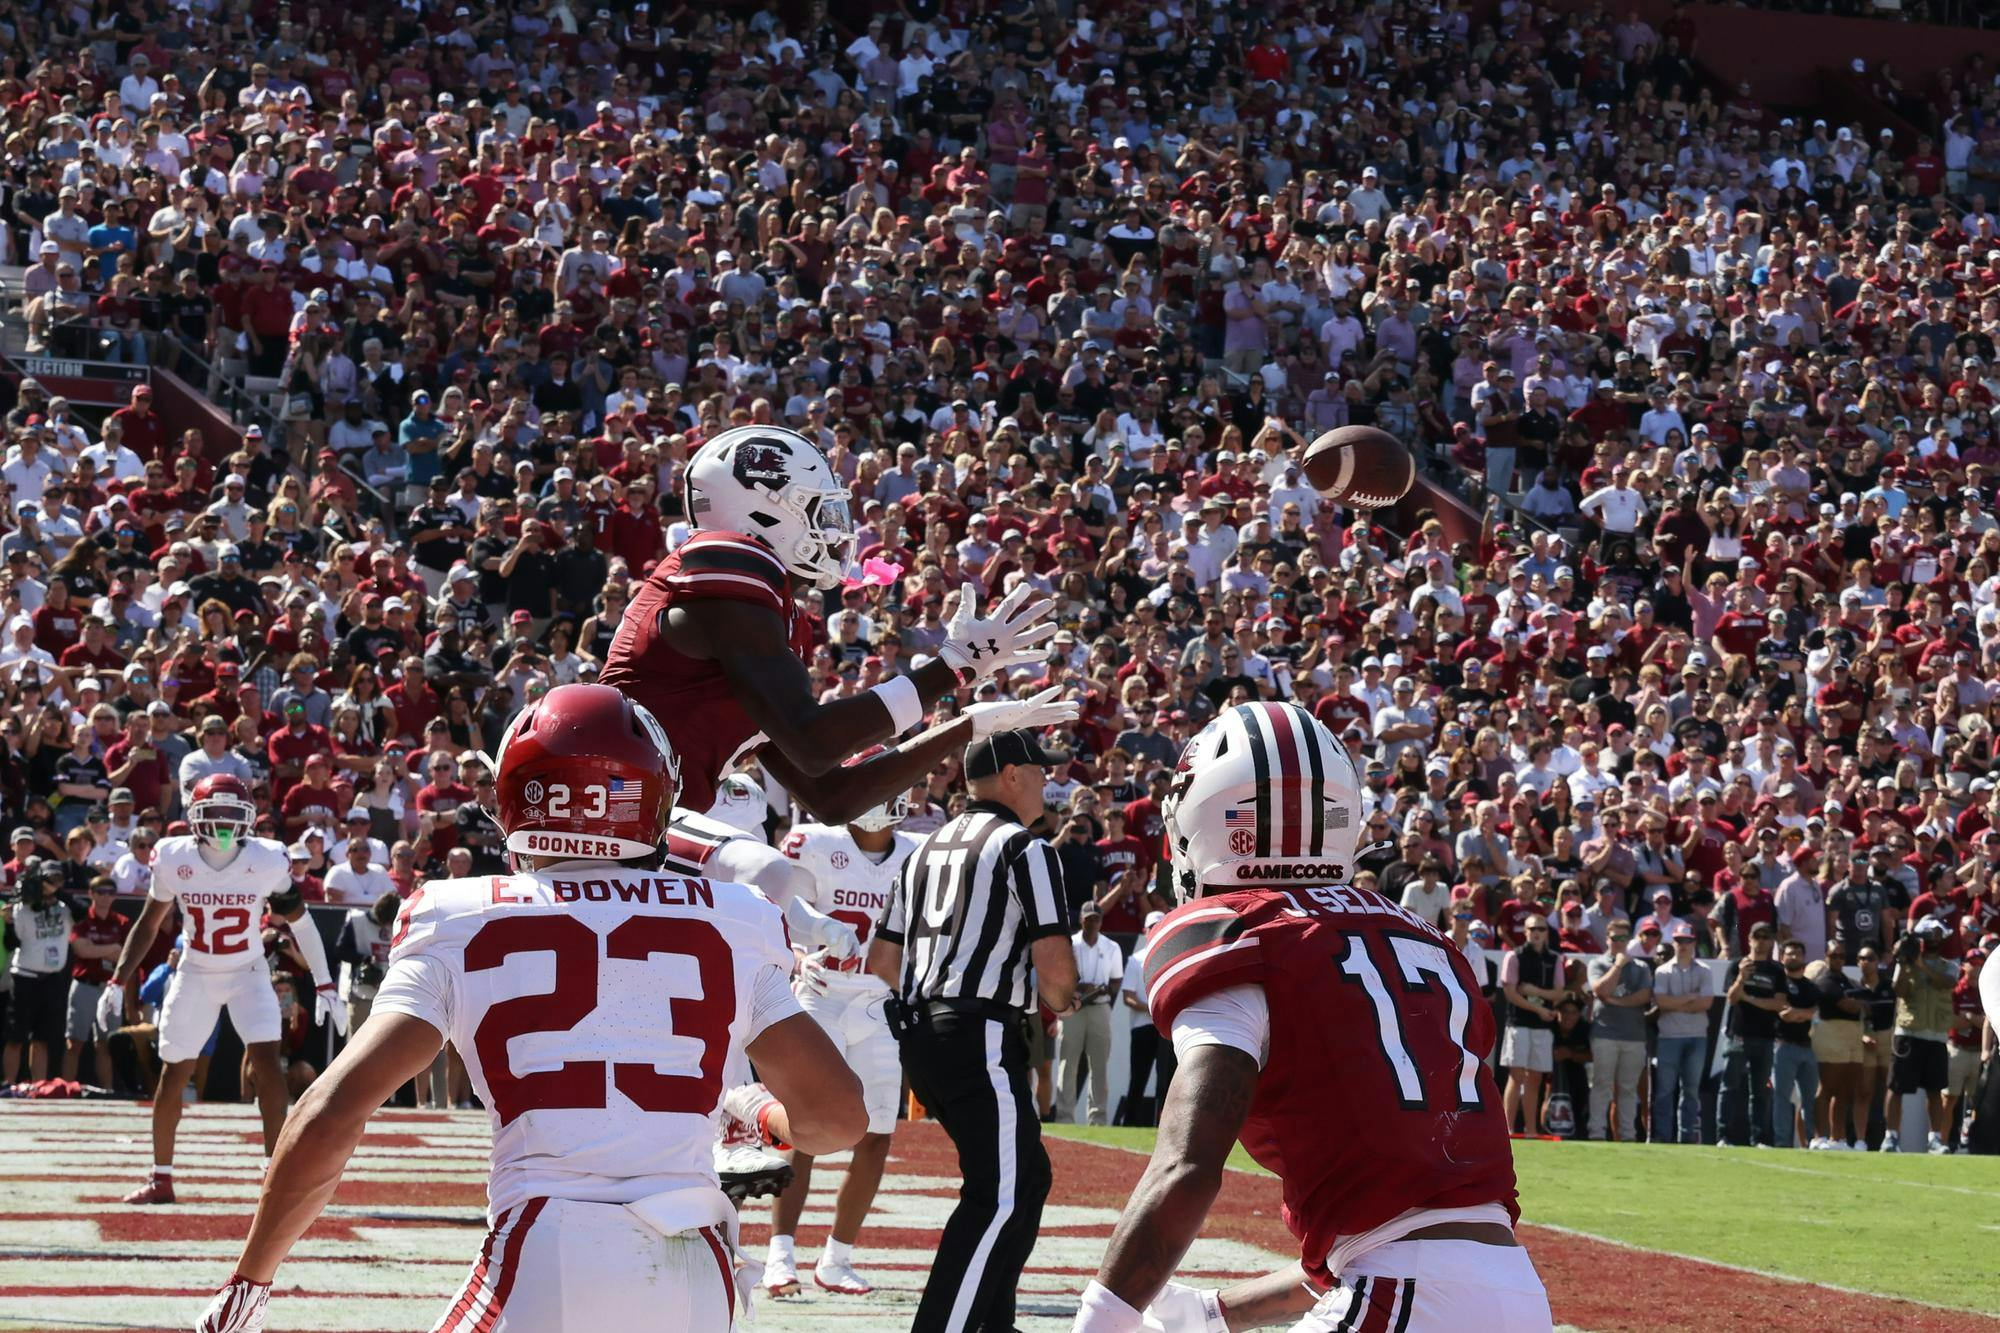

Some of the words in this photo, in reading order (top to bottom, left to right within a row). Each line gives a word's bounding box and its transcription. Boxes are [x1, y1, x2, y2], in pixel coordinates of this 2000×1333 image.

[25, 360, 84, 376] SECTION
[525, 781, 544, 803] SEC
[548, 784, 607, 818] 23
[527, 835, 620, 857] SOONERS
[1229, 830, 1255, 855] SEC
[831, 851, 849, 869] SEC
[1236, 864, 1344, 880] GAMECOCKS
[181, 893, 257, 905] SOONERS
[491, 877, 533, 904] E.
[552, 877, 715, 909] BOWEN
[833, 889, 889, 909] SOON
[187, 906, 250, 955] 12
[464, 914, 737, 1128] 23
[1334, 930, 1484, 1111] 17
